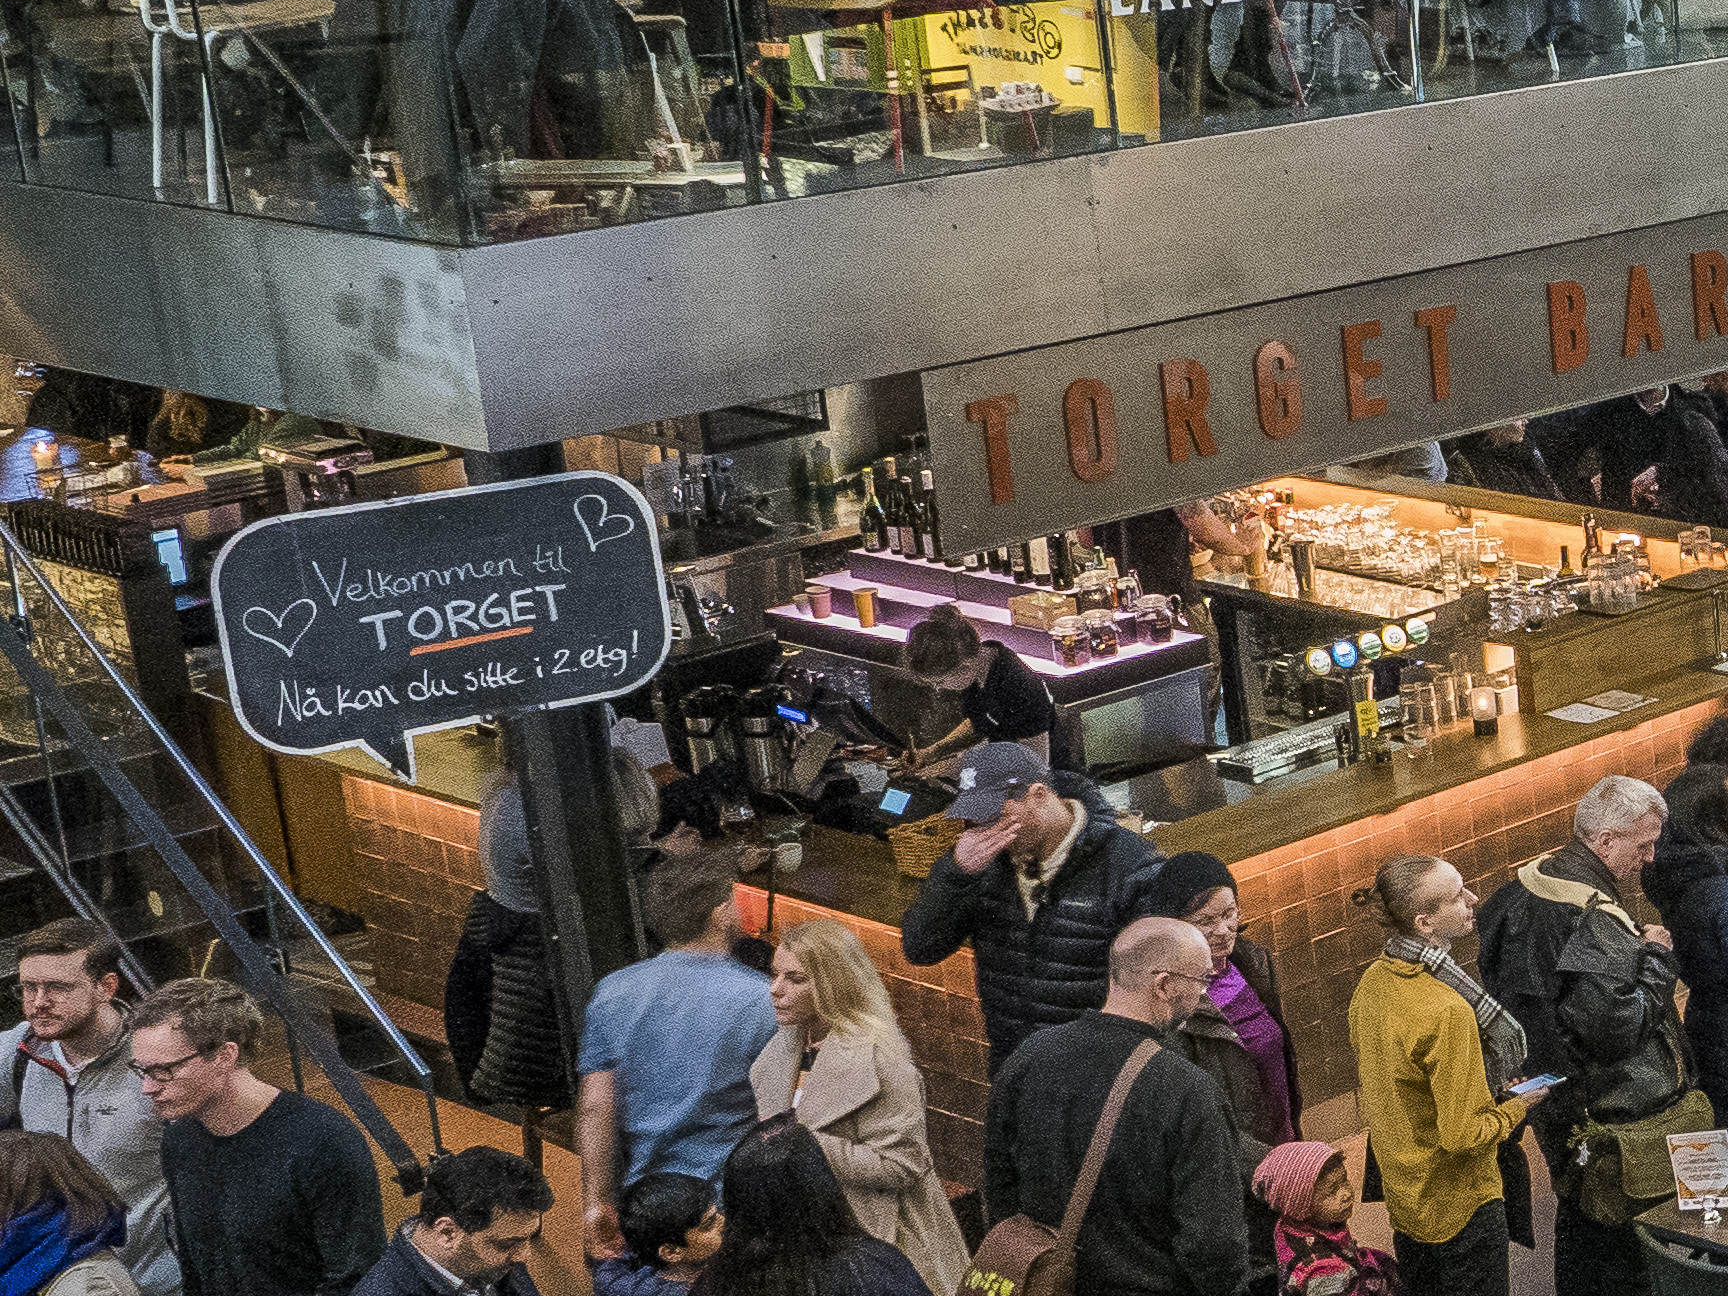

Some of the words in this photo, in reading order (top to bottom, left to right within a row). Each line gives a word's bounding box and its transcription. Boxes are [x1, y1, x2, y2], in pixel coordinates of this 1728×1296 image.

[965, 304, 1460, 507] TORGET
[311, 555, 519, 606] Velkommen
[531, 545, 568, 578] til
[360, 582, 567, 650] TORGET
[276, 677, 334, 726] Nå
[336, 681, 401, 714] kan
[407, 666, 459, 702] du
[465, 658, 528, 692] sitte
[534, 654, 547, 681] i
